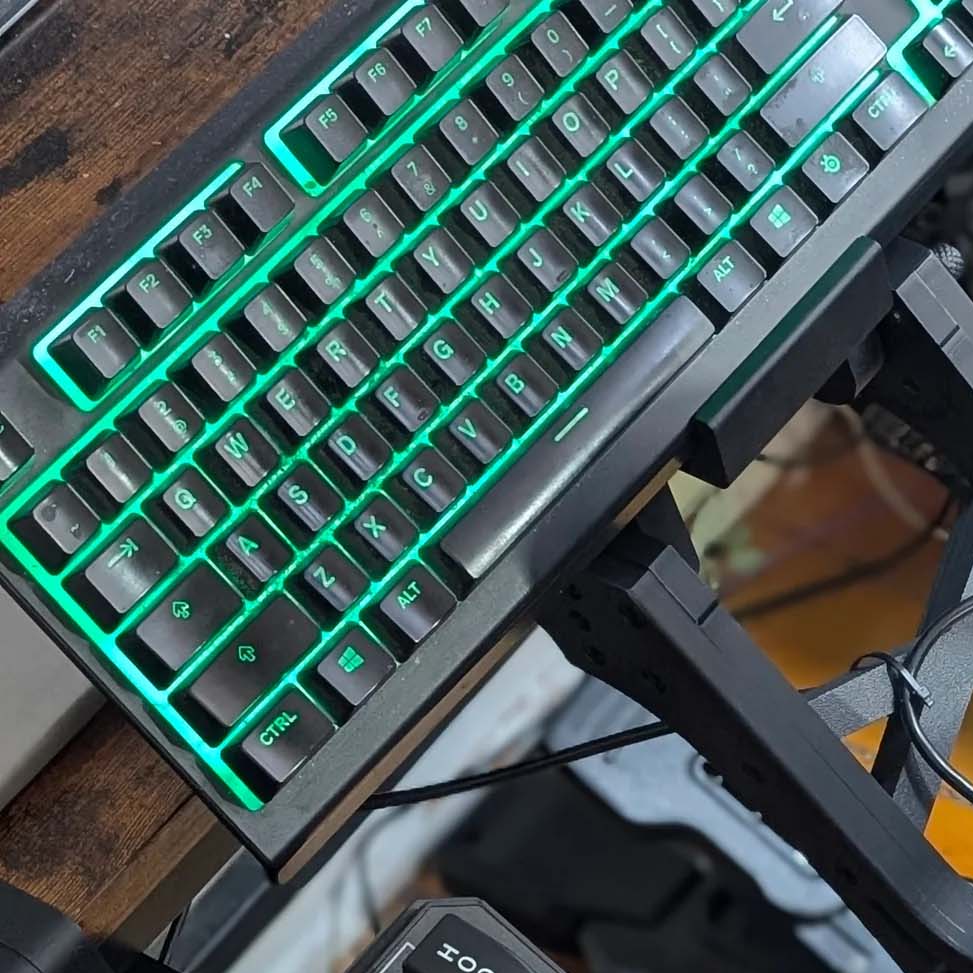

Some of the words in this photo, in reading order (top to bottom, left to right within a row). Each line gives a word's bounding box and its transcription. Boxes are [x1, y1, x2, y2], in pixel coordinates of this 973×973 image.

[415, 17, 433, 38] F7
[367, 63, 387, 83] F6
[502, 72, 514, 87] 9
[604, 69, 619, 91] P
[318, 108, 339, 129] F5
[454, 115, 468, 131] 8
[406, 161, 418, 177] 7
[613, 163, 633, 179] L
[242, 175, 263, 197] F4
[359, 208, 372, 223] 6
[468, 200, 488, 221] U
[570, 202, 590, 223] K
[192, 224, 214, 246] F3
[422, 246, 440, 267] Y
[528, 248, 543, 268] J
[712, 255, 735, 283] ALT
[139, 273, 161, 294] F2
[596, 276, 620, 302] M
[373, 291, 393, 313] T
[478, 292, 500, 315] H
[87, 324, 107, 343] F1
[550, 326, 573, 349] N
[325, 339, 347, 363] R
[433, 338, 455, 360] G
[504, 373, 526, 395] B
[156, 400, 173, 416] 2
[275, 387, 296, 411] E
[383, 386, 400, 408] F
[457, 418, 477, 439] V
[223, 431, 249, 459] W
[335, 434, 357, 456] D
[413, 467, 433, 487] C
[174, 488, 197, 511] Q
[288, 484, 309, 505] S
[362, 515, 387, 538] X
[237, 535, 259, 556] A
[312, 566, 336, 589] Z
[396, 580, 423, 610] ALT
[259, 711, 298, 747] CTRL
